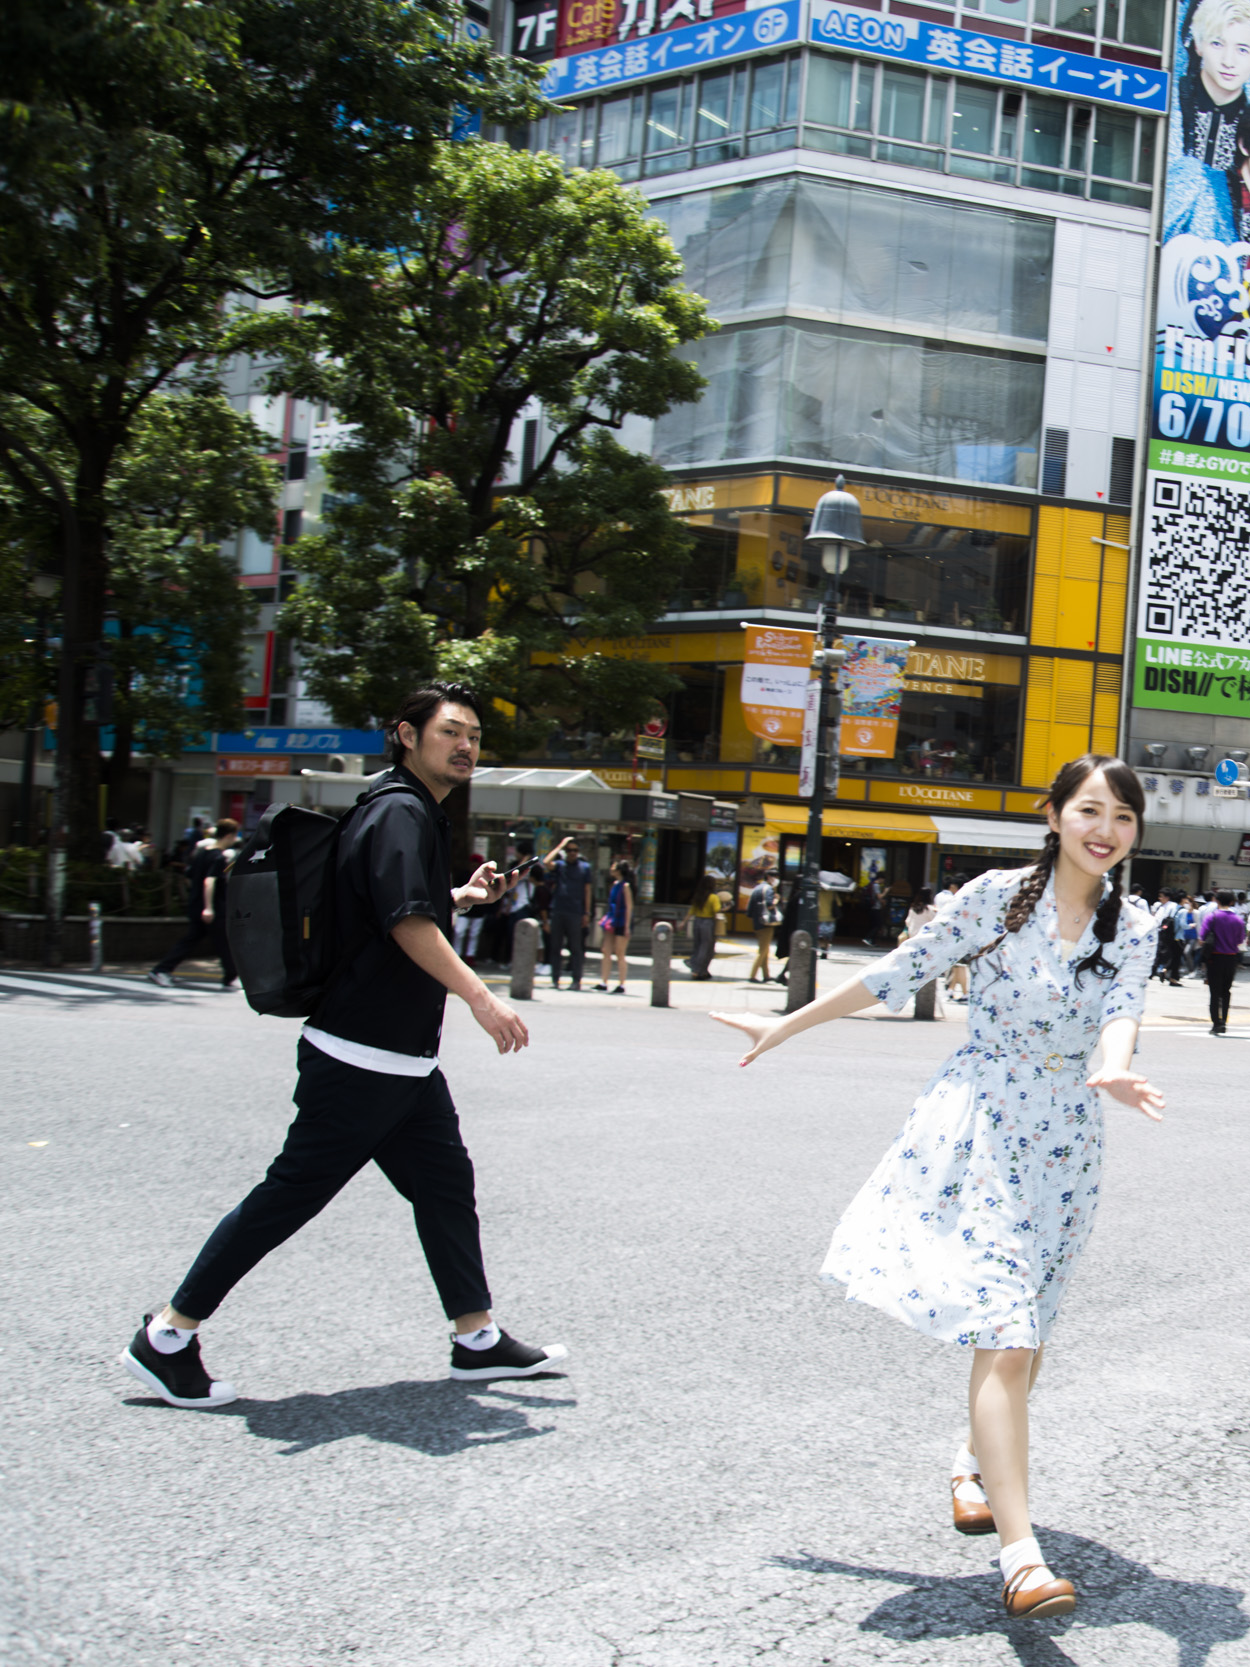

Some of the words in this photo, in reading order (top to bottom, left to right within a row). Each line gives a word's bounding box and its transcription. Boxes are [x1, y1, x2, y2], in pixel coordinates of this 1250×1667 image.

[518, 9, 558, 51] 7F
[821, 9, 906, 51] AEON
[573, 24, 747, 90] 英会話イーオン
[925, 28, 1163, 102] 英会話イーオン
[1158, 393, 1224, 443] 6/7
[901, 680, 954, 694] VENCE
